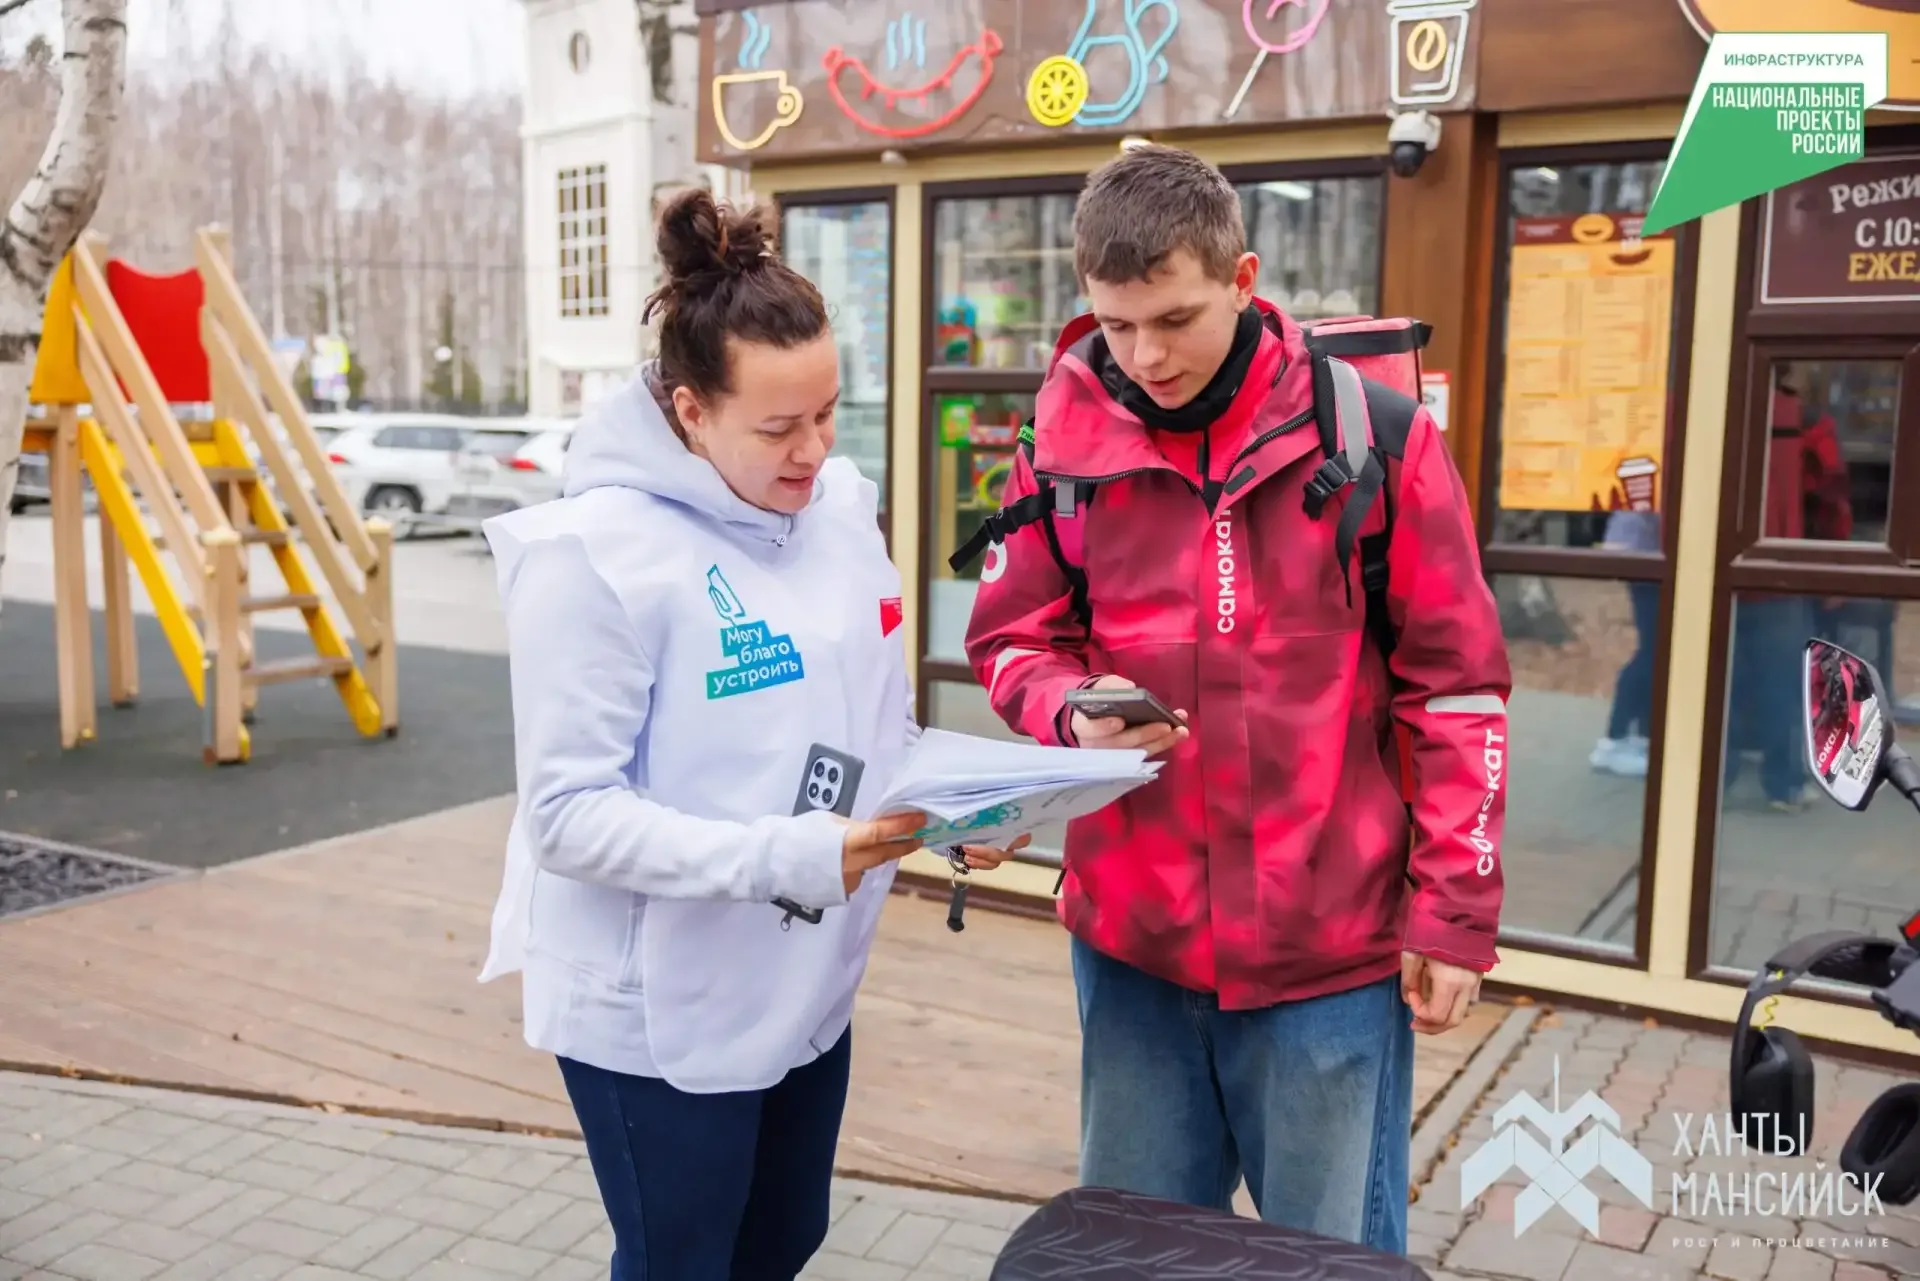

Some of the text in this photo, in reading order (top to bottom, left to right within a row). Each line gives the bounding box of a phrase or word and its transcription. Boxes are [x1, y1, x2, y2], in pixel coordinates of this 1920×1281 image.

[1855, 218, 1877, 248] С
[1848, 251, 1920, 282] ЕЖЕ
[726, 627, 763, 647] Могу
[740, 641, 790, 665] благо
[713, 659, 799, 695] устроить
